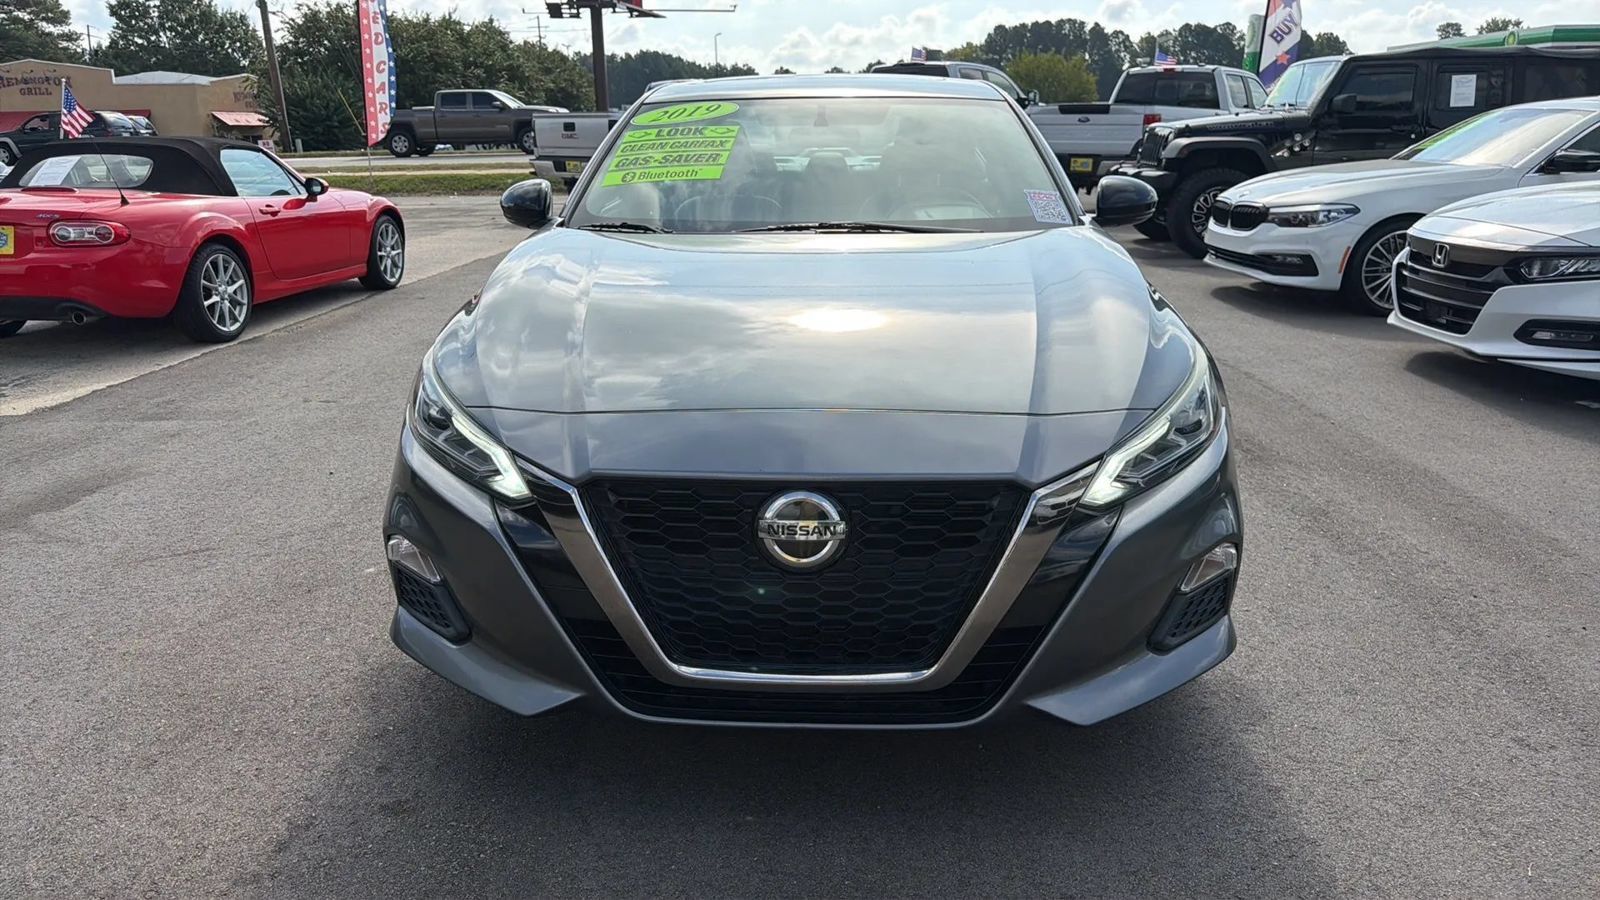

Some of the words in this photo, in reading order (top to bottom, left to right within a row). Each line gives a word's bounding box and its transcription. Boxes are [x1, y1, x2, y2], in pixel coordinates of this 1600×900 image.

[1269, 11, 1298, 44] BUY
[19, 87, 52, 96] GRILL
[375, 60, 390, 134] CARS
[648, 103, 722, 122] 2019
[655, 127, 706, 138] LOOK
[620, 140, 669, 153] CLEAN
[669, 138, 730, 150] CARFAX
[615, 152, 722, 168] GAS-SAVER
[637, 169, 698, 181] Bluetooth
[767, 525, 837, 537] NISSAN
